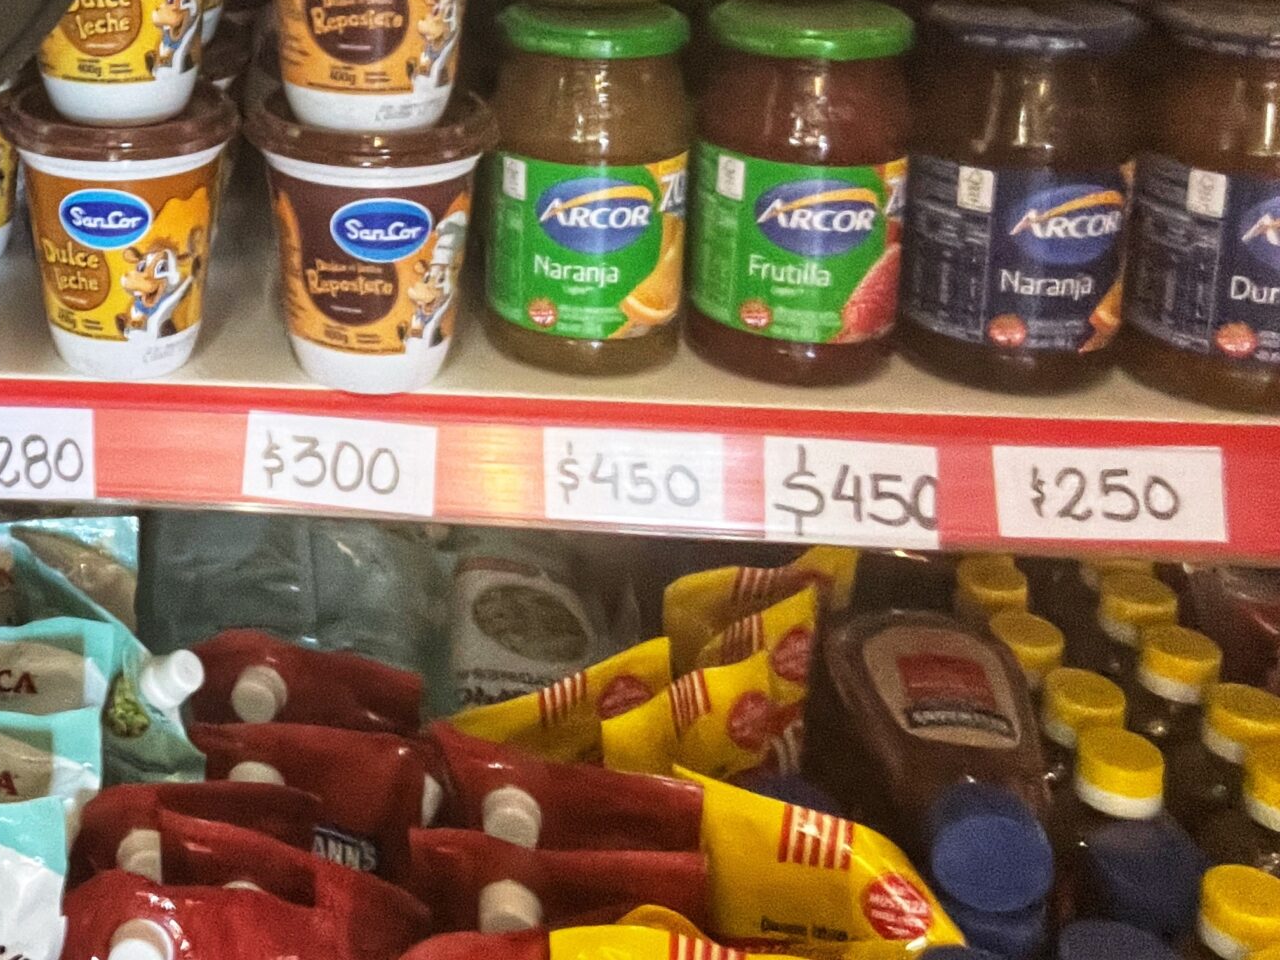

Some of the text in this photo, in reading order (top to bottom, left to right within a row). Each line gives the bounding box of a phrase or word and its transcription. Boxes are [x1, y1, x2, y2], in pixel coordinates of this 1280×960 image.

[75, 12, 130, 40] leche
[310, 5, 404, 36] Repostero
[69, 205, 144, 230] SanCor
[540, 197, 651, 229] ARCOR
[757, 198, 877, 233] ARCOR
[1009, 208, 1123, 239] ARCOR
[344, 218, 424, 242] SanCor
[41, 237, 100, 270] Dulce
[55, 267, 100, 291] leche
[304, 268, 394, 298] Repostero
[534, 254, 620, 288] Naranja
[748, 253, 832, 288] Frutilla
[999, 269, 1093, 302] Naranja
[261, 429, 401, 496] $300
[557, 440, 701, 509] $450
[773, 444, 939, 537] $450
[1030, 465, 1181, 523] $250
